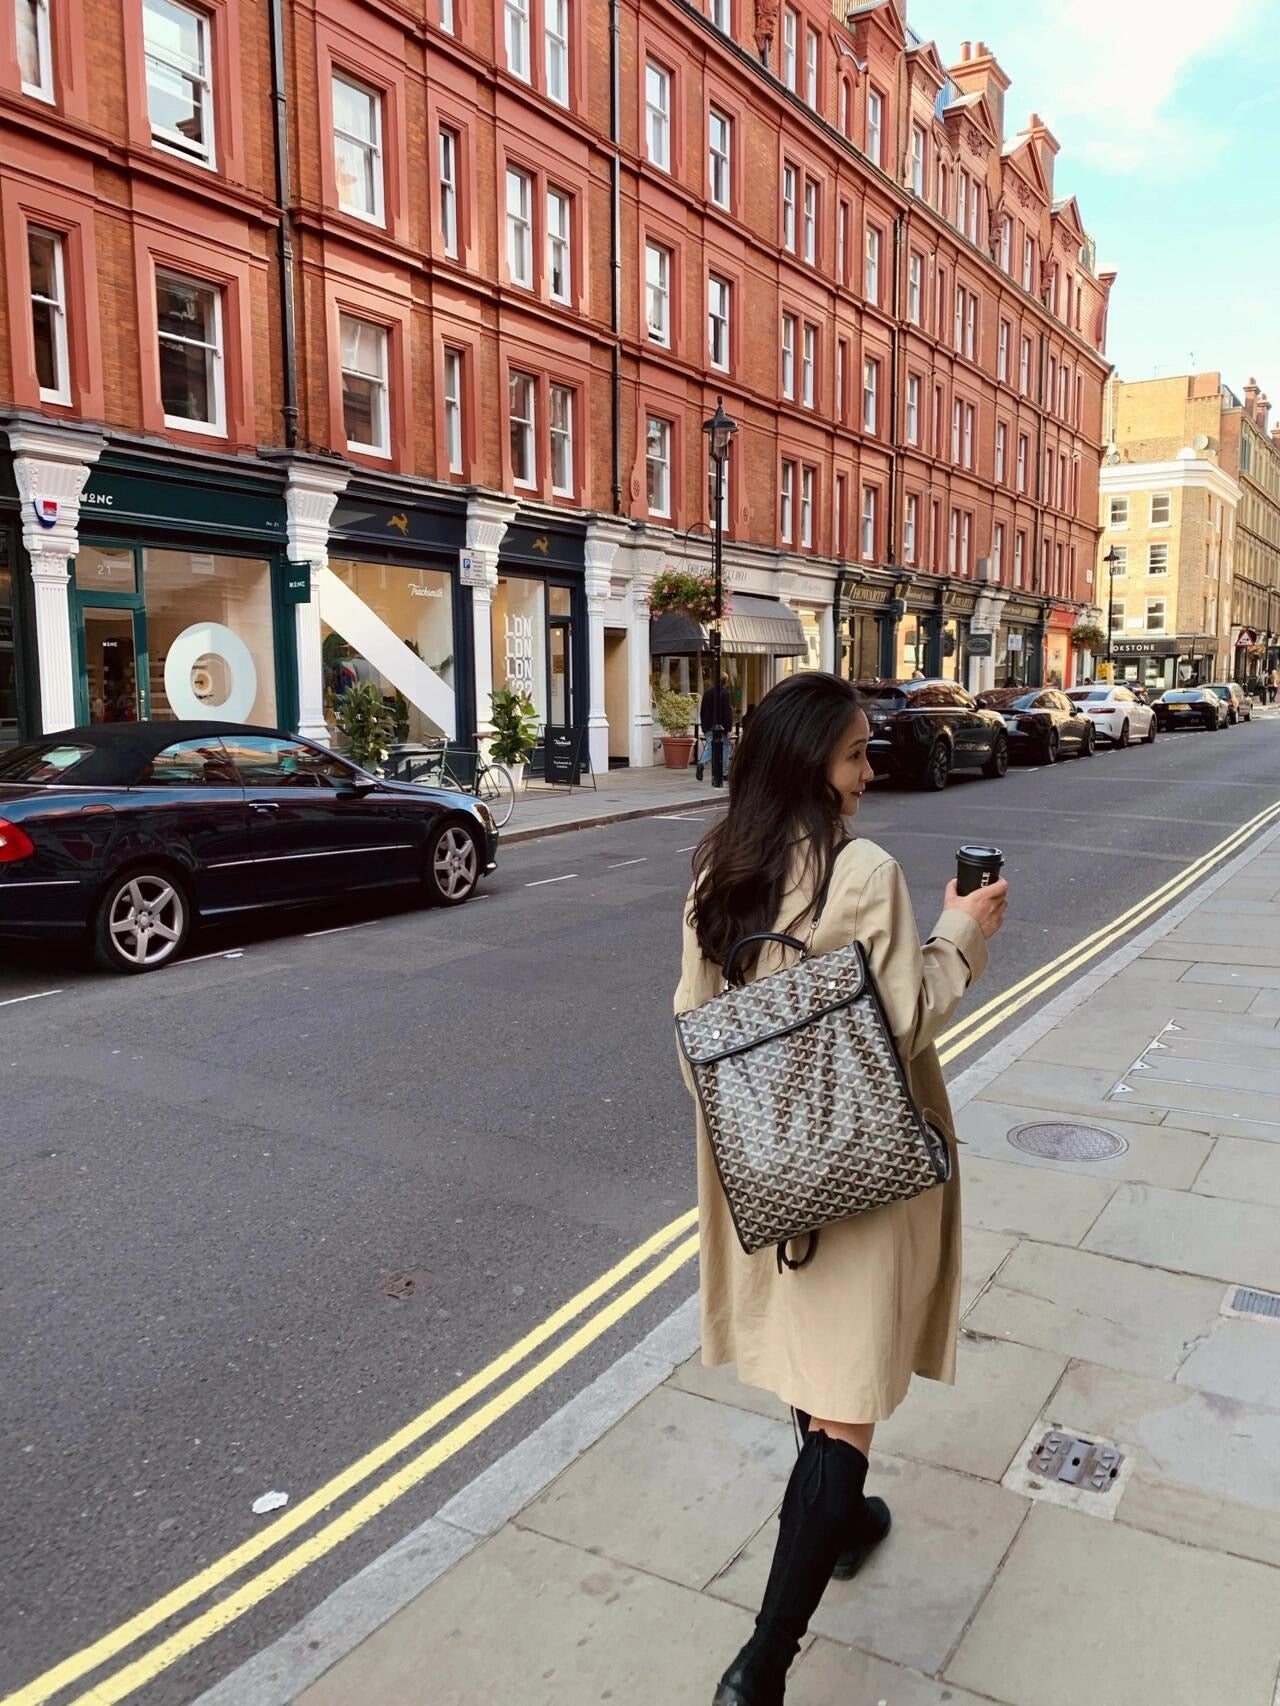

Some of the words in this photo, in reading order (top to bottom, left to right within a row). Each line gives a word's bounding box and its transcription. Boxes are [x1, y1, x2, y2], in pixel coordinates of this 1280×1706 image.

[97, 564, 111, 576] 21
[504, 613, 533, 637] LDN
[504, 635, 534, 660] LDN
[1112, 644, 1156, 652] OKSTONE
[505, 657, 535, 681] LDN
